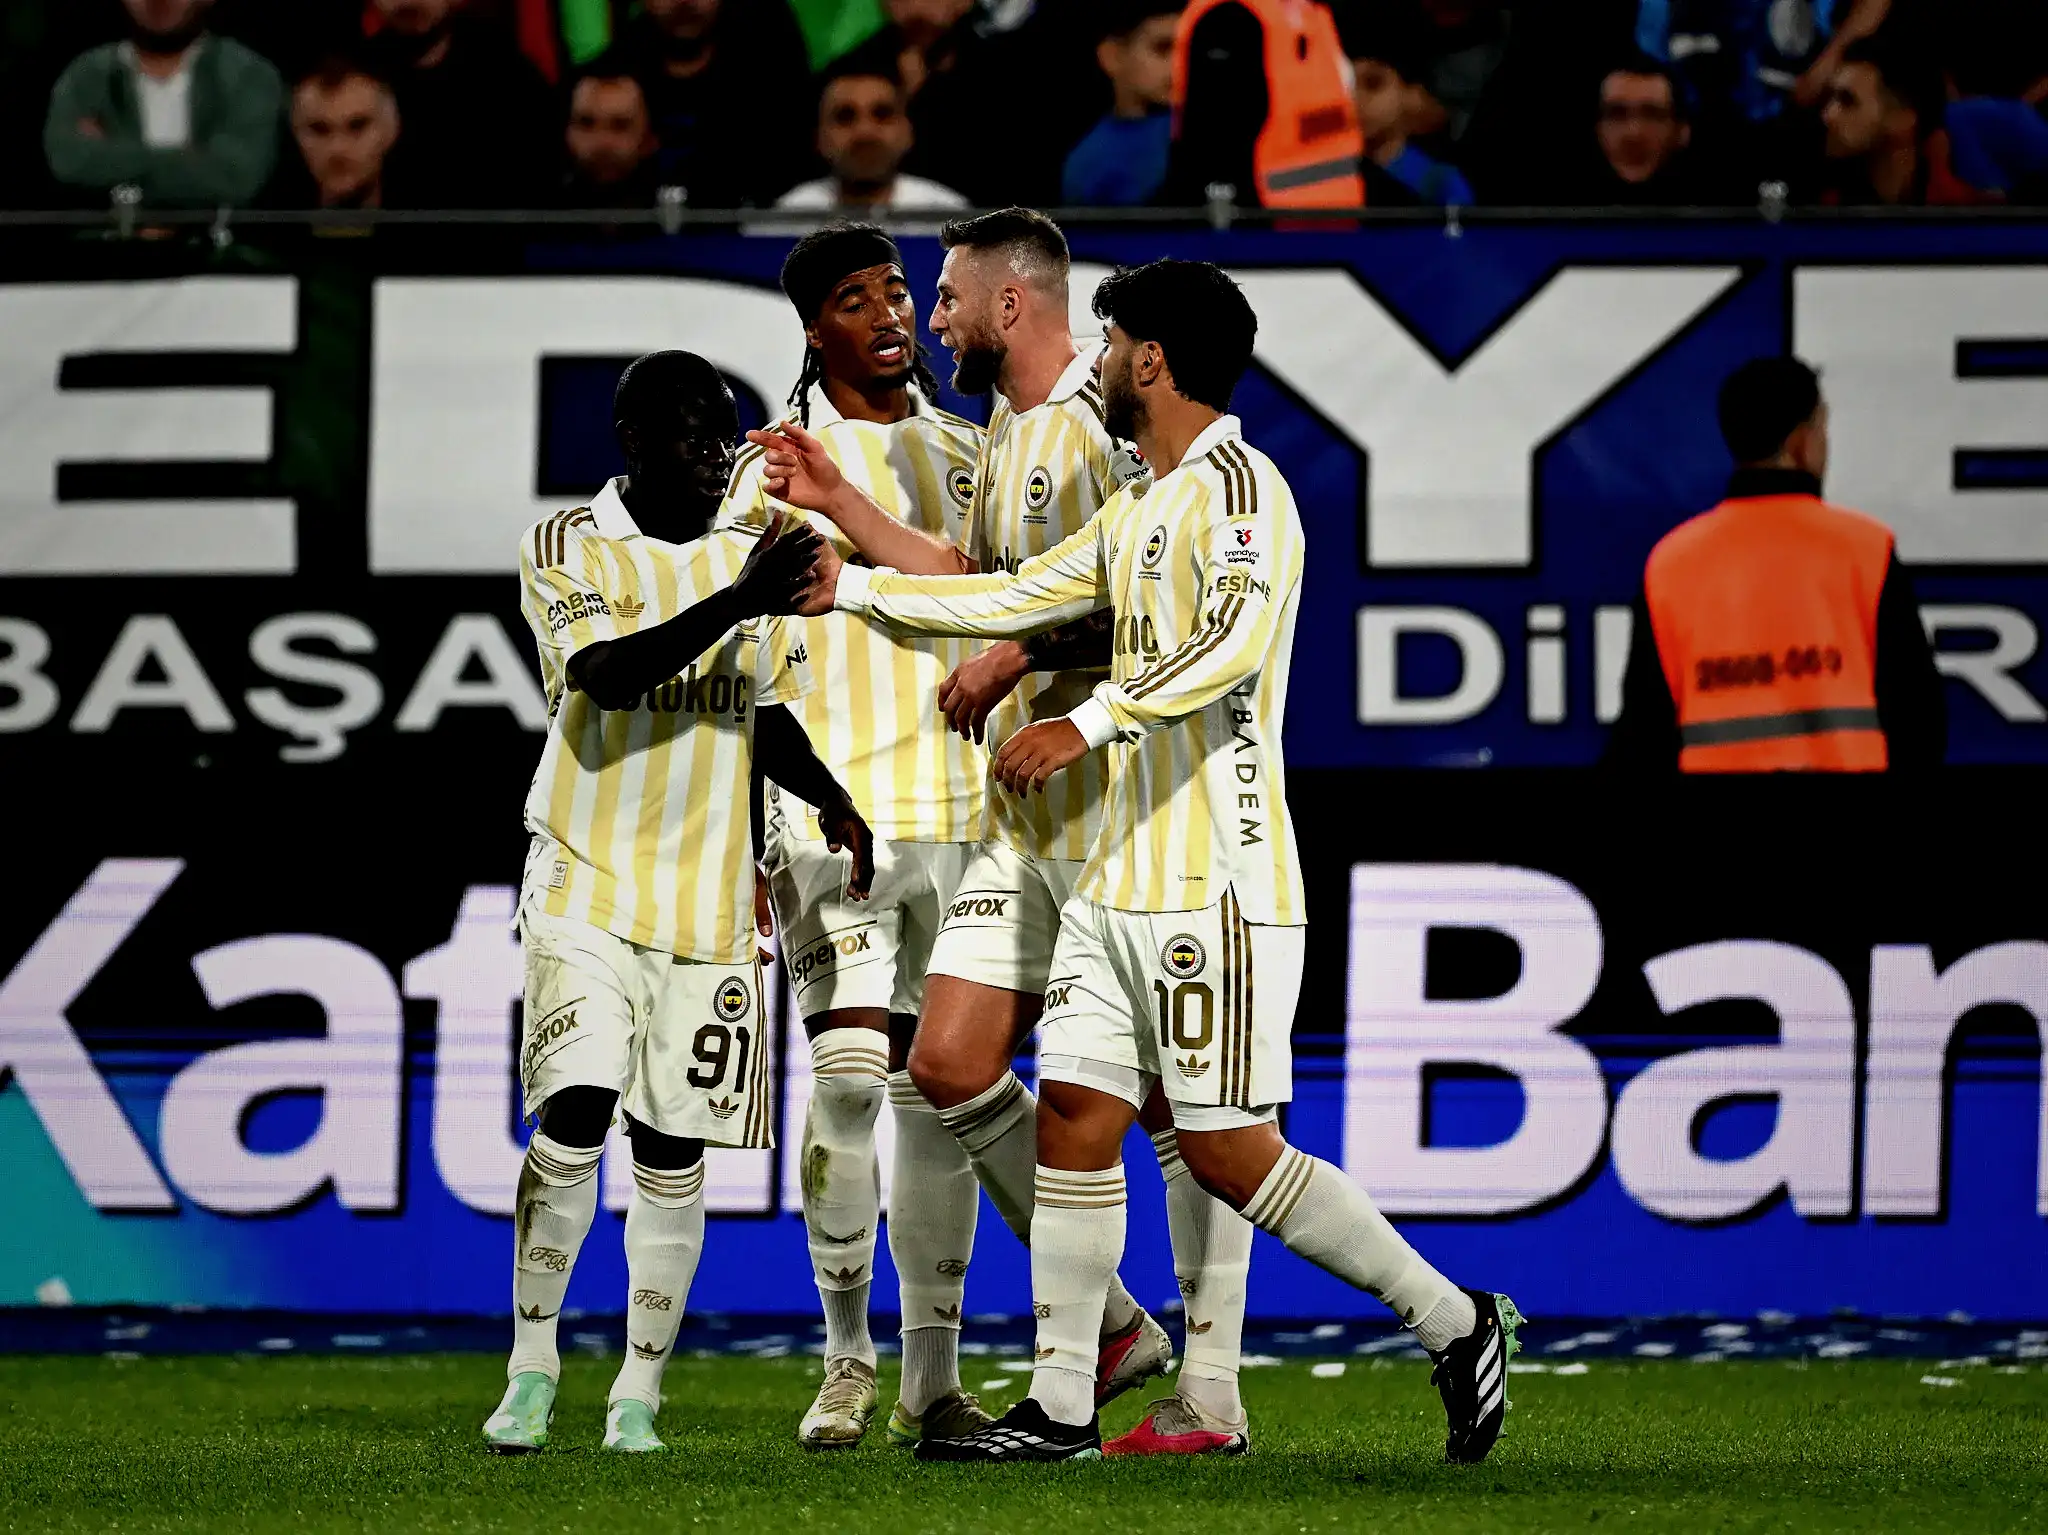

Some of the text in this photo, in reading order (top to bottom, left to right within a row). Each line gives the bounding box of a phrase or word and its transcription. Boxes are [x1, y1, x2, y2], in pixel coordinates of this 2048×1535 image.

[941, 898, 1009, 930] perox
[1154, 978, 1215, 1051] 10
[686, 1023, 751, 1094] 91
